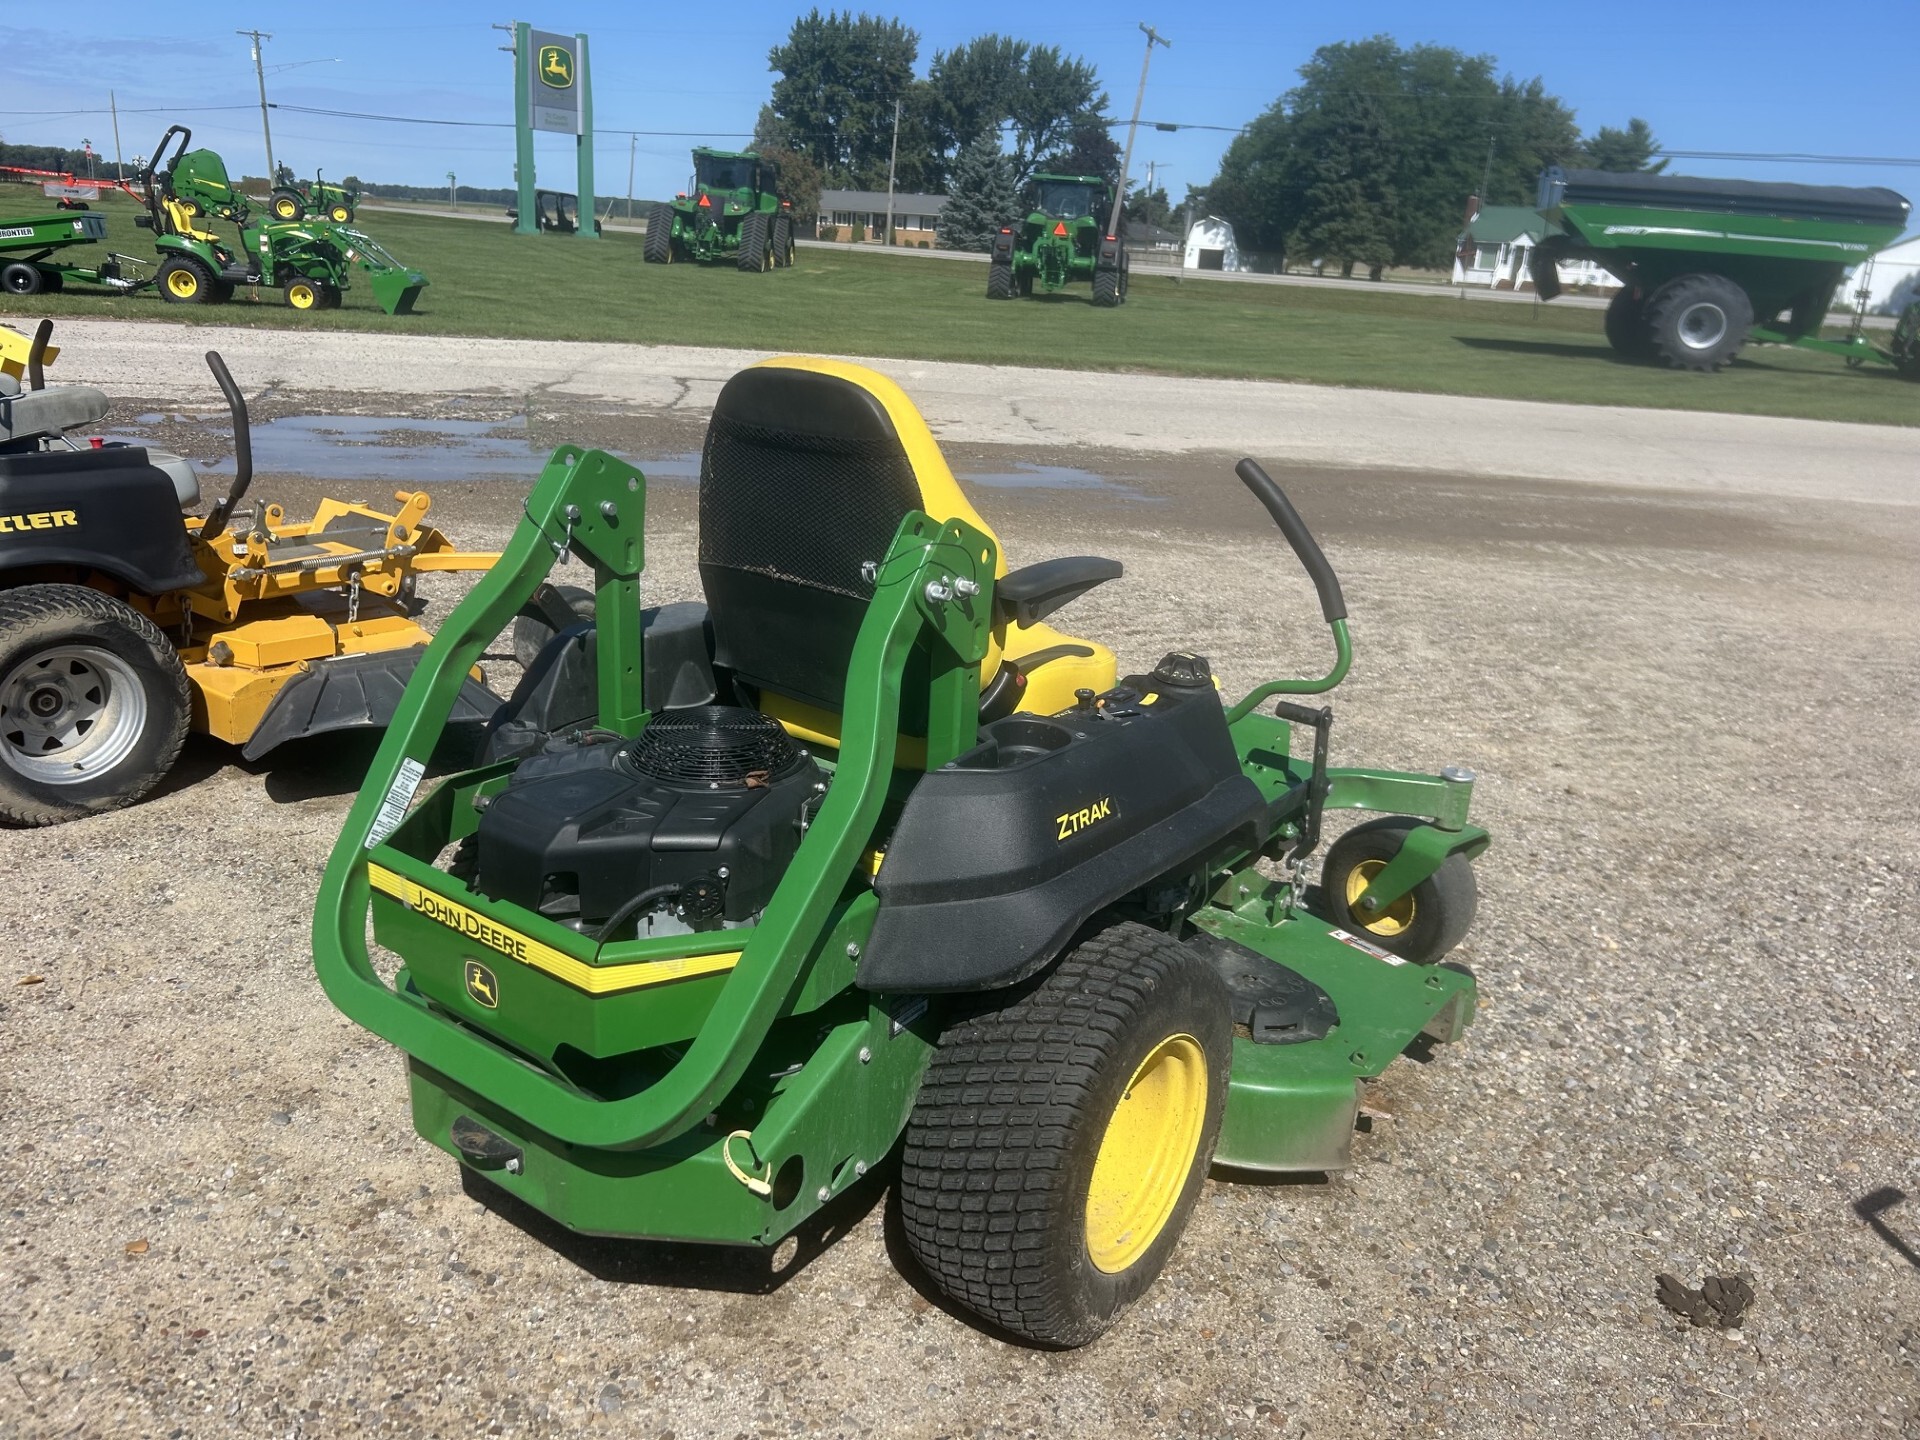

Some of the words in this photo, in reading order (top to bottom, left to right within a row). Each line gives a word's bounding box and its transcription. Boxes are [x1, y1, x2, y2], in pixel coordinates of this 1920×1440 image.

[0, 228, 33, 238] RONTIER
[1056, 797, 1111, 841] ZTRAK
[413, 890, 462, 929] JOHN
[465, 913, 527, 961] DEERE
